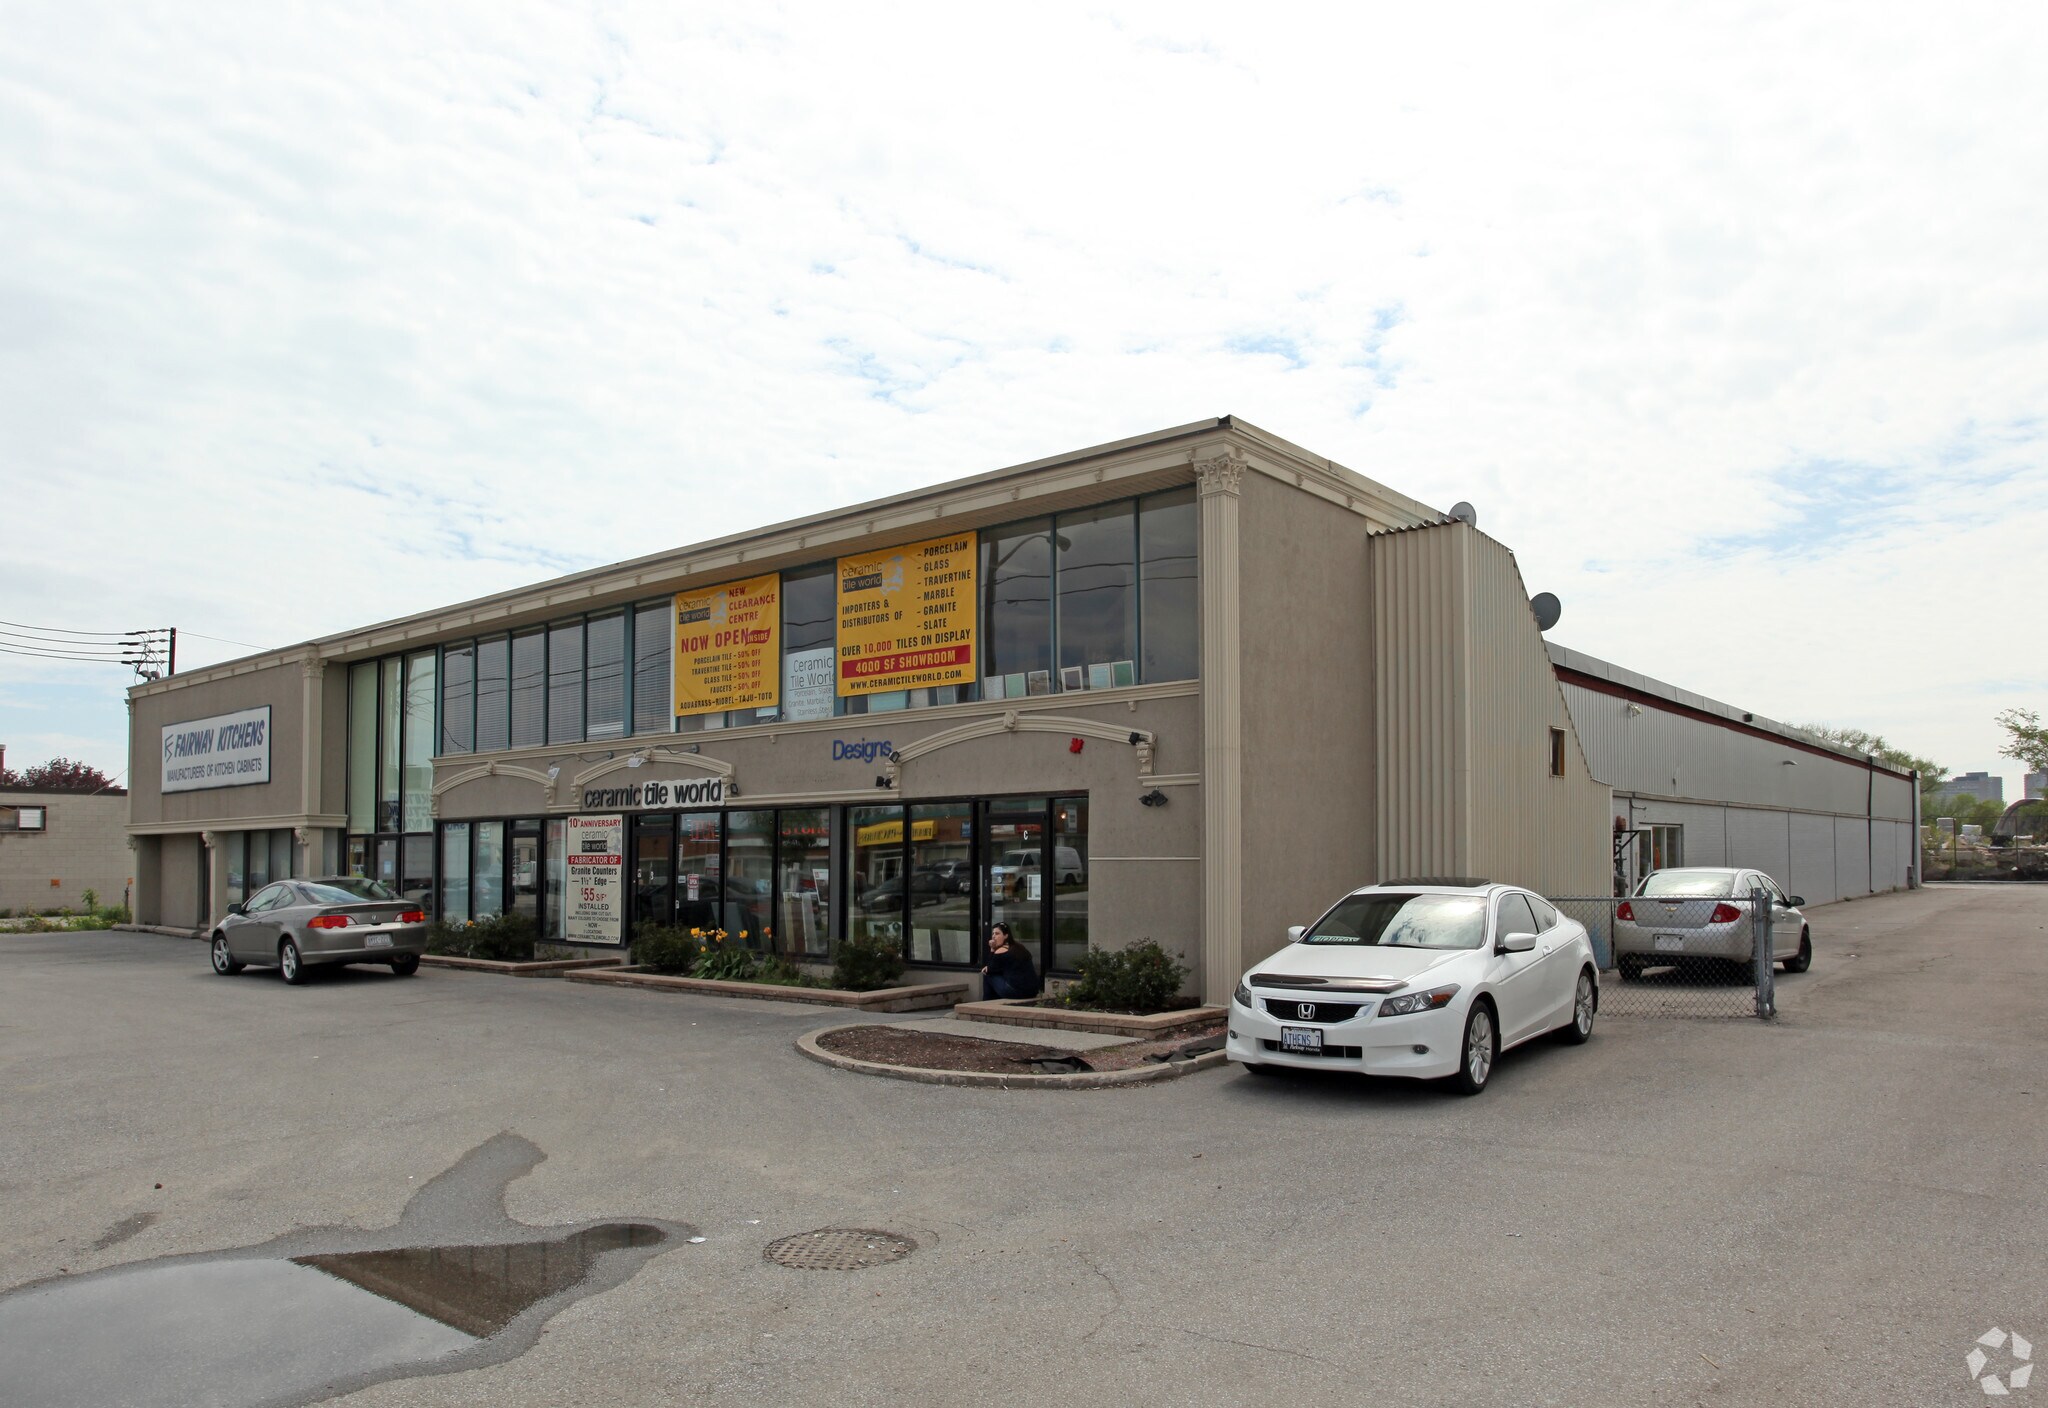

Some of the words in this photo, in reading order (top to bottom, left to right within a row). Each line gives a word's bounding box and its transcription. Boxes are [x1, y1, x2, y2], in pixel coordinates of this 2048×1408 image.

[924, 541, 968, 558] PORCELAIN
[842, 561, 882, 578] ceramic
[924, 559, 949, 572] GLASS
[843, 580, 856, 590] tile
[858, 574, 882, 587] world
[924, 570, 971, 586] TRAVERTINE
[729, 587, 746, 598] NEW
[924, 587, 954, 600] MARBLE
[679, 597, 710, 610] ceramic
[729, 594, 775, 611] CLEARANCE
[842, 600, 880, 615] IMPORTERS
[884, 599, 889, 608] &
[924, 602, 957, 615] GRANITE
[680, 612, 691, 622] tile
[691, 610, 710, 621] world
[729, 611, 758, 624] CENTRE
[842, 613, 889, 628] DISTRIBUTORS
[895, 611, 902, 620] OF
[924, 618, 947, 630] SLATE
[682, 635, 709, 653] NOW
[715, 628, 748, 647] OPEN
[748, 632, 768, 642] INSIDE
[842, 645, 861, 656] OVER
[864, 640, 891, 654] 10,000
[896, 637, 918, 649] TILES
[921, 635, 931, 646] ON
[936, 629, 970, 644] DISPLAY
[694, 655, 720, 664] PORCELAIN
[794, 656, 832, 672] Ceramic
[856, 660, 880, 673] 4000
[884, 658, 895, 670] SF
[900, 650, 956, 668] SHOWROOM
[692, 666, 720, 675] TRAVERTINE
[704, 676, 720, 684] GLASS
[791, 675, 804, 688] Tile
[850, 670, 961, 690] WWW.CERAMICTILEWORLD.COM
[710, 685, 732, 694] FAUCETS
[174, 728, 214, 758] FAIRWAY
[217, 720, 265, 752] KITCHENS
[832, 738, 892, 764] Designs
[167, 765, 206, 782] MANUFACTURERS
[207, 764, 214, 777] OF
[214, 761, 235, 776] KITCHEN
[237, 758, 262, 773] CABINETS
[584, 784, 642, 808] ceramic
[644, 782, 668, 805] tile
[674, 779, 722, 804] world
[580, 819, 621, 827] ANNIVERSARY
[582, 830, 607, 839] ceramic
[591, 842, 607, 850] world
[571, 866, 591, 875] Granite
[592, 867, 617, 875] Counters
[594, 876, 607, 887] Edge
[1283, 1033, 1312, 1046] ATHENS
[1315, 1036, 1320, 1047] 7
